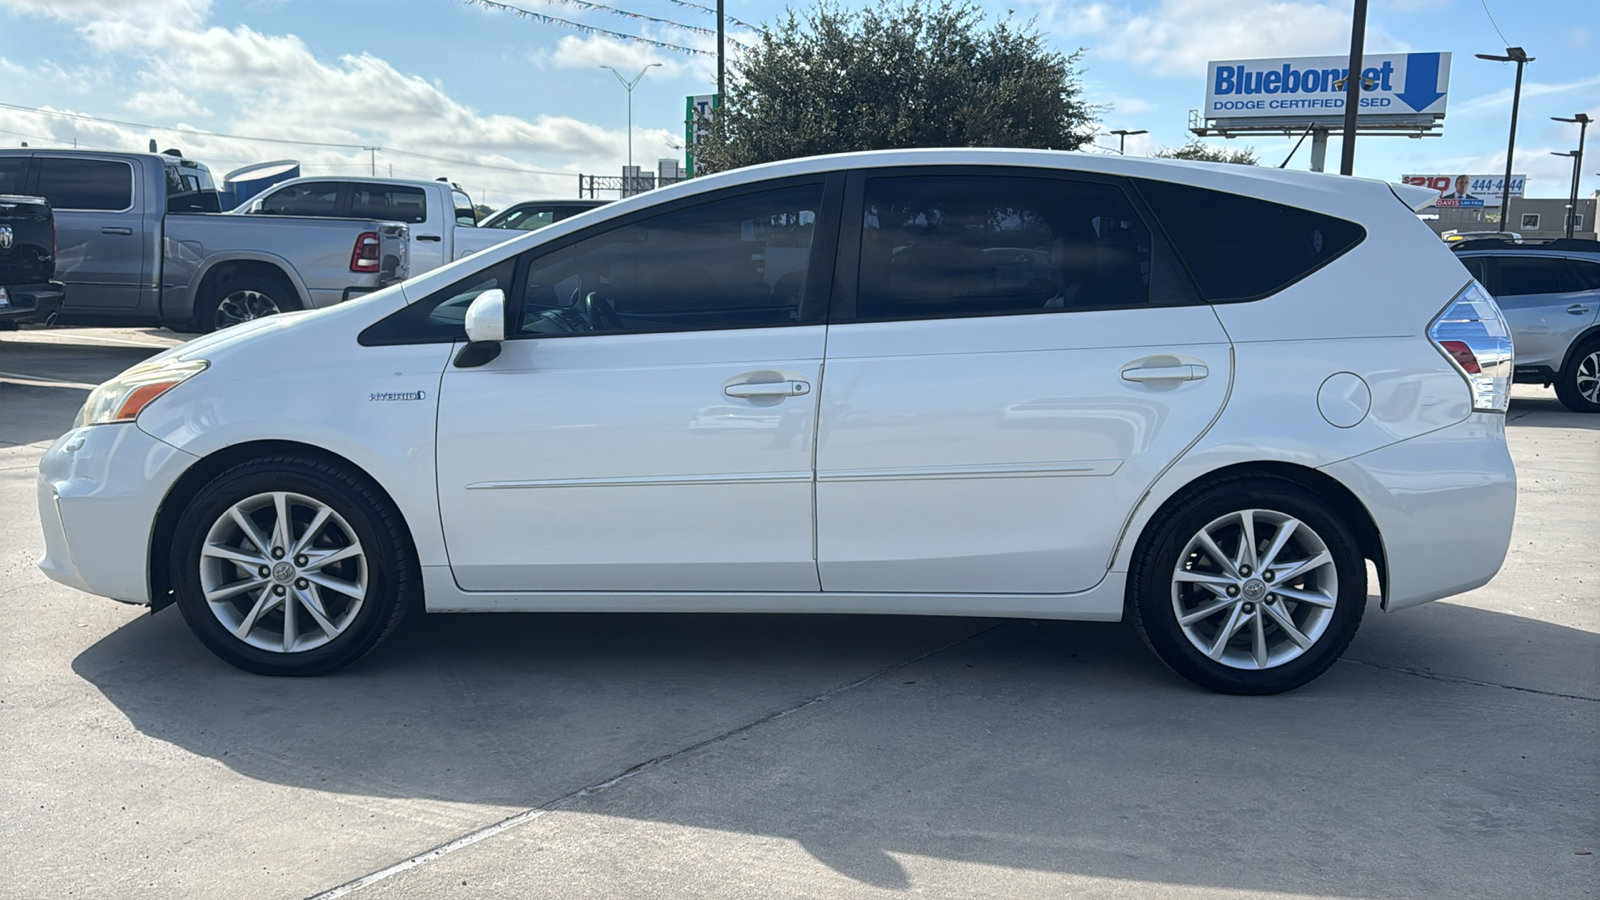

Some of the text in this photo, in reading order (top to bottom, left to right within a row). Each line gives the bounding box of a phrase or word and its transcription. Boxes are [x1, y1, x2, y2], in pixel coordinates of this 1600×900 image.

[1213, 97, 1391, 110] DODGE CERTIFIED SED
[1471, 179, 1524, 191] 444-444
[368, 392, 417, 402] HYBRID
